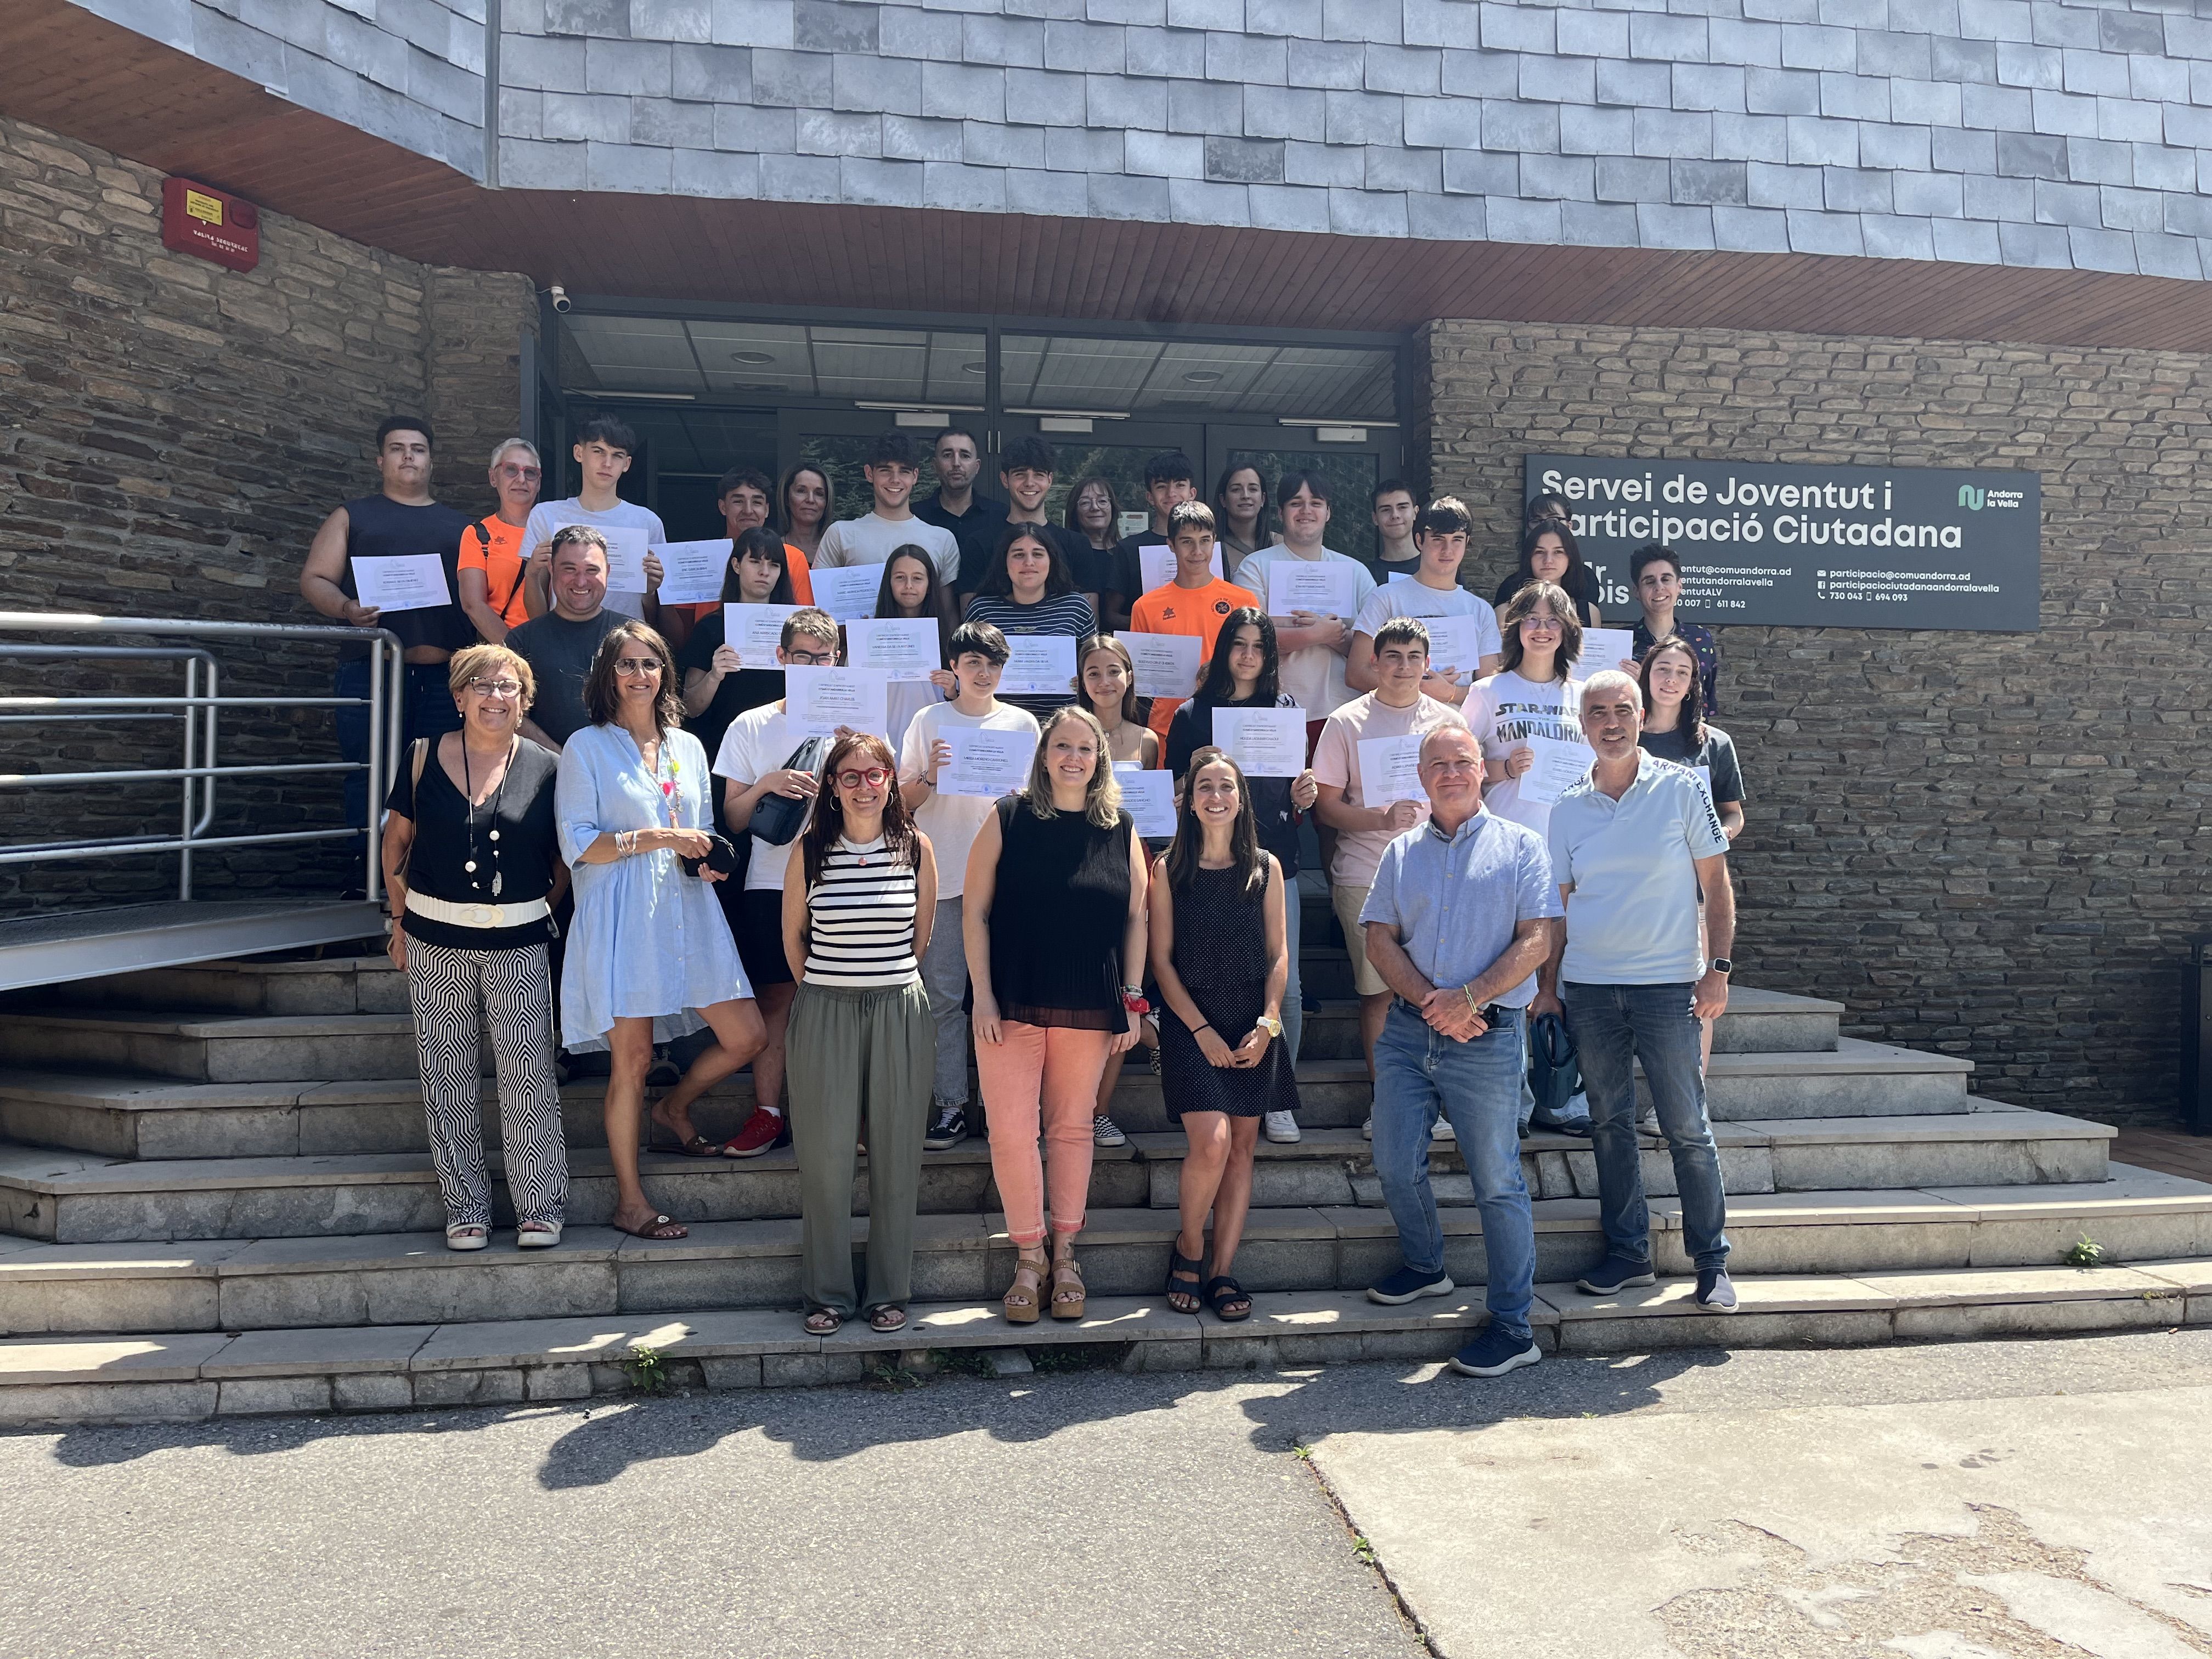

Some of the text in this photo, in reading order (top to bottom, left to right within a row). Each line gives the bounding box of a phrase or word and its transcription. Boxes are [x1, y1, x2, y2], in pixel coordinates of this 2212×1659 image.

[1542, 470, 1892, 510] Servei de Joventut i
[1987, 489, 2023, 499] Andorra
[1987, 499, 2019, 508] la Vella
[1570, 508, 1962, 549] articipació Ciutadana
[1680, 565, 1792, 576] entut@comuandorra.ad
[1829, 569, 1971, 581] participacio@comuandorra.ad
[1680, 577, 1774, 587] entutandorralavella
[1829, 580, 2000, 593] participaciociutadanaandorralavella
[1680, 588, 1723, 596] entutALV
[1892, 594, 1908, 602] 093
[1495, 703, 1580, 718] STAR WAR
[1652, 759, 1725, 844] ARMANI EXCHANGE
